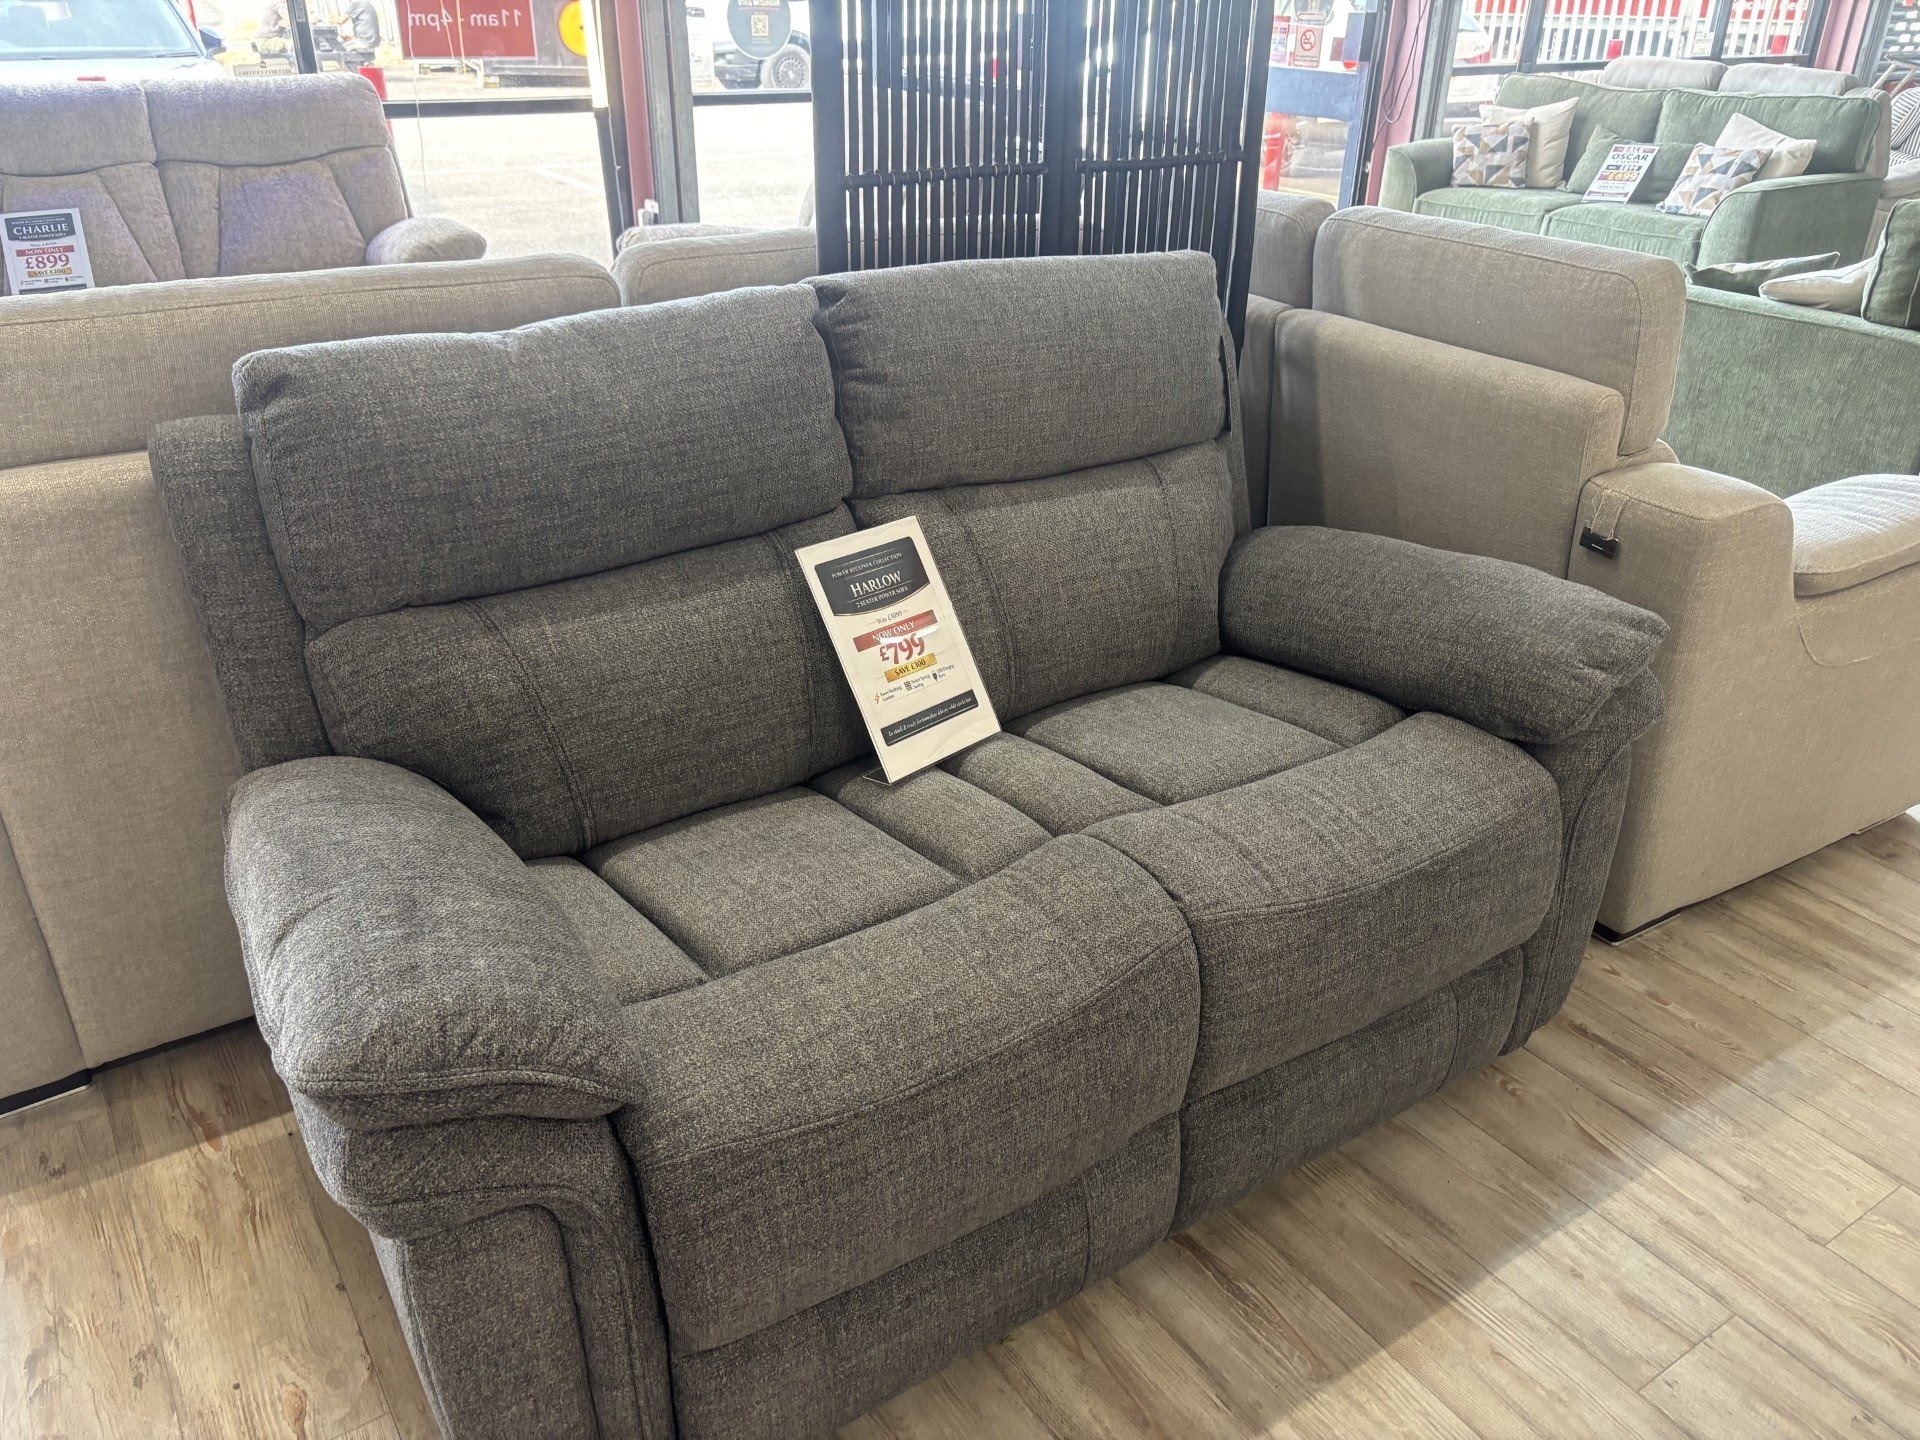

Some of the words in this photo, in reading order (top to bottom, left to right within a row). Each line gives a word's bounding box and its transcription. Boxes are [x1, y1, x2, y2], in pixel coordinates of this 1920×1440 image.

[13, 223, 69, 235] CHARLIE
[25, 254, 70, 269] £899
[850, 571, 901, 597] HARLOW
[860, 596, 877, 606] SEATER
[896, 586, 908, 594] SOFA
[872, 629, 892, 642] NOW
[893, 620, 915, 634] ONLY
[880, 632, 925, 664] £799
[894, 665, 910, 676] SAVE
